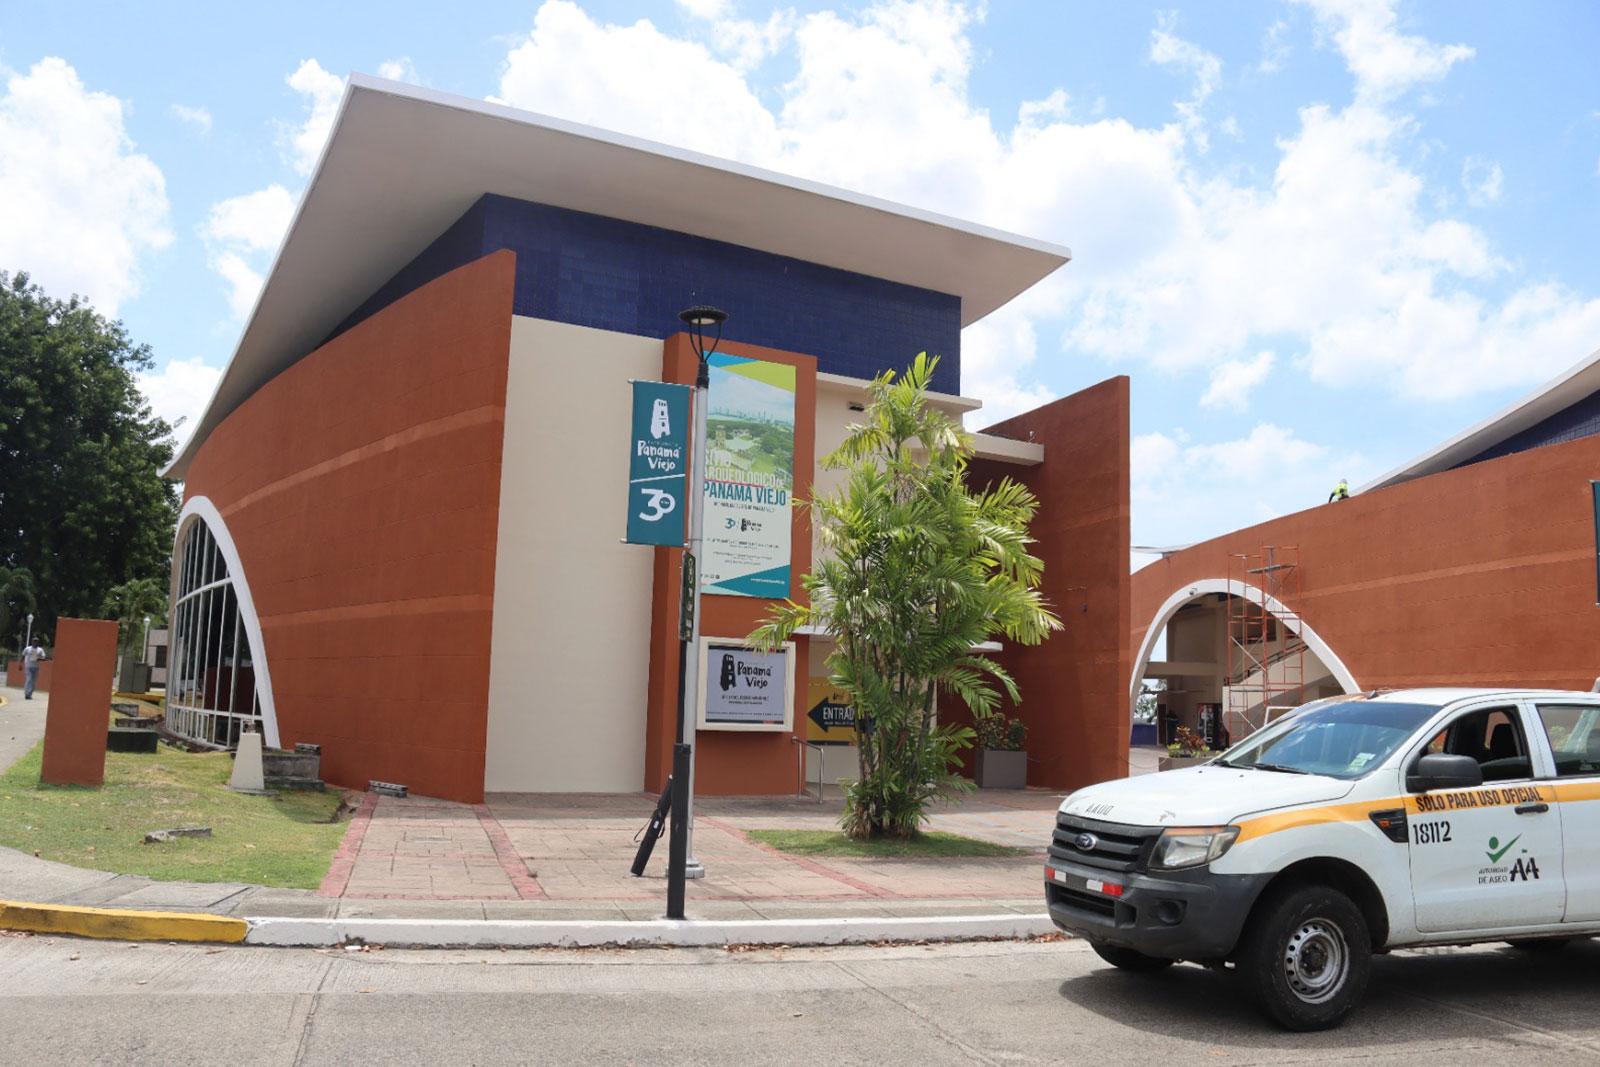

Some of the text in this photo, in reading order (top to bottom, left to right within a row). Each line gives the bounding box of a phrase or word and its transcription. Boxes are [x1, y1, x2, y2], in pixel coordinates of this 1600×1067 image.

[647, 457, 676, 472] Viejo
[756, 486, 787, 506] VIEJO
[745, 676, 769, 689] Viejo
[823, 707, 855, 721] ENTRAD
[1416, 786, 1544, 812] SOLO PARA USO OFICIAL
[1413, 820, 1452, 845] 18112
[1489, 875, 1508, 884] ASEO
